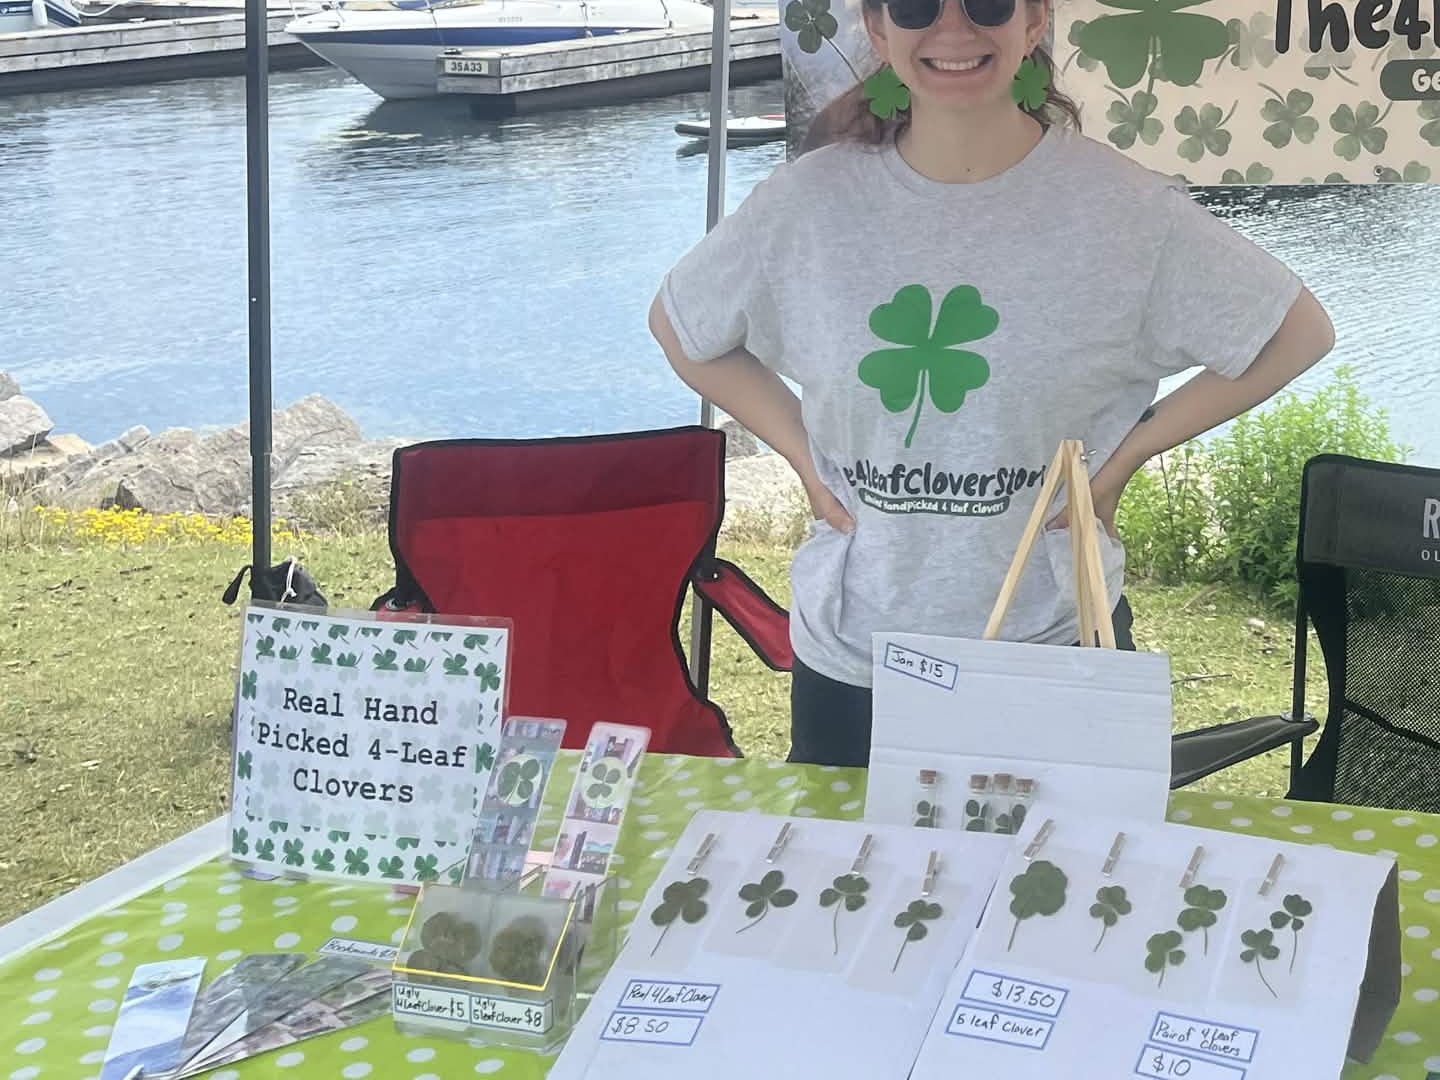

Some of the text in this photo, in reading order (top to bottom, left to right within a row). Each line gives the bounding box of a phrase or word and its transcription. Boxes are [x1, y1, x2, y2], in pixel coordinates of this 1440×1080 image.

[450, 61, 483, 73] 35A33
[919, 657, 944, 678] $15
[282, 687, 439, 726] Real Hand
[257, 722, 469, 769] Picked 4-Leaf
[292, 767, 415, 804] Clovers
[524, 1007, 543, 1028] $8
[956, 1013, 967, 1025] 5
[1001, 1021, 1044, 1037] Clover
[1199, 1039, 1241, 1057] Clovers
[1152, 1053, 1192, 1077] $10
